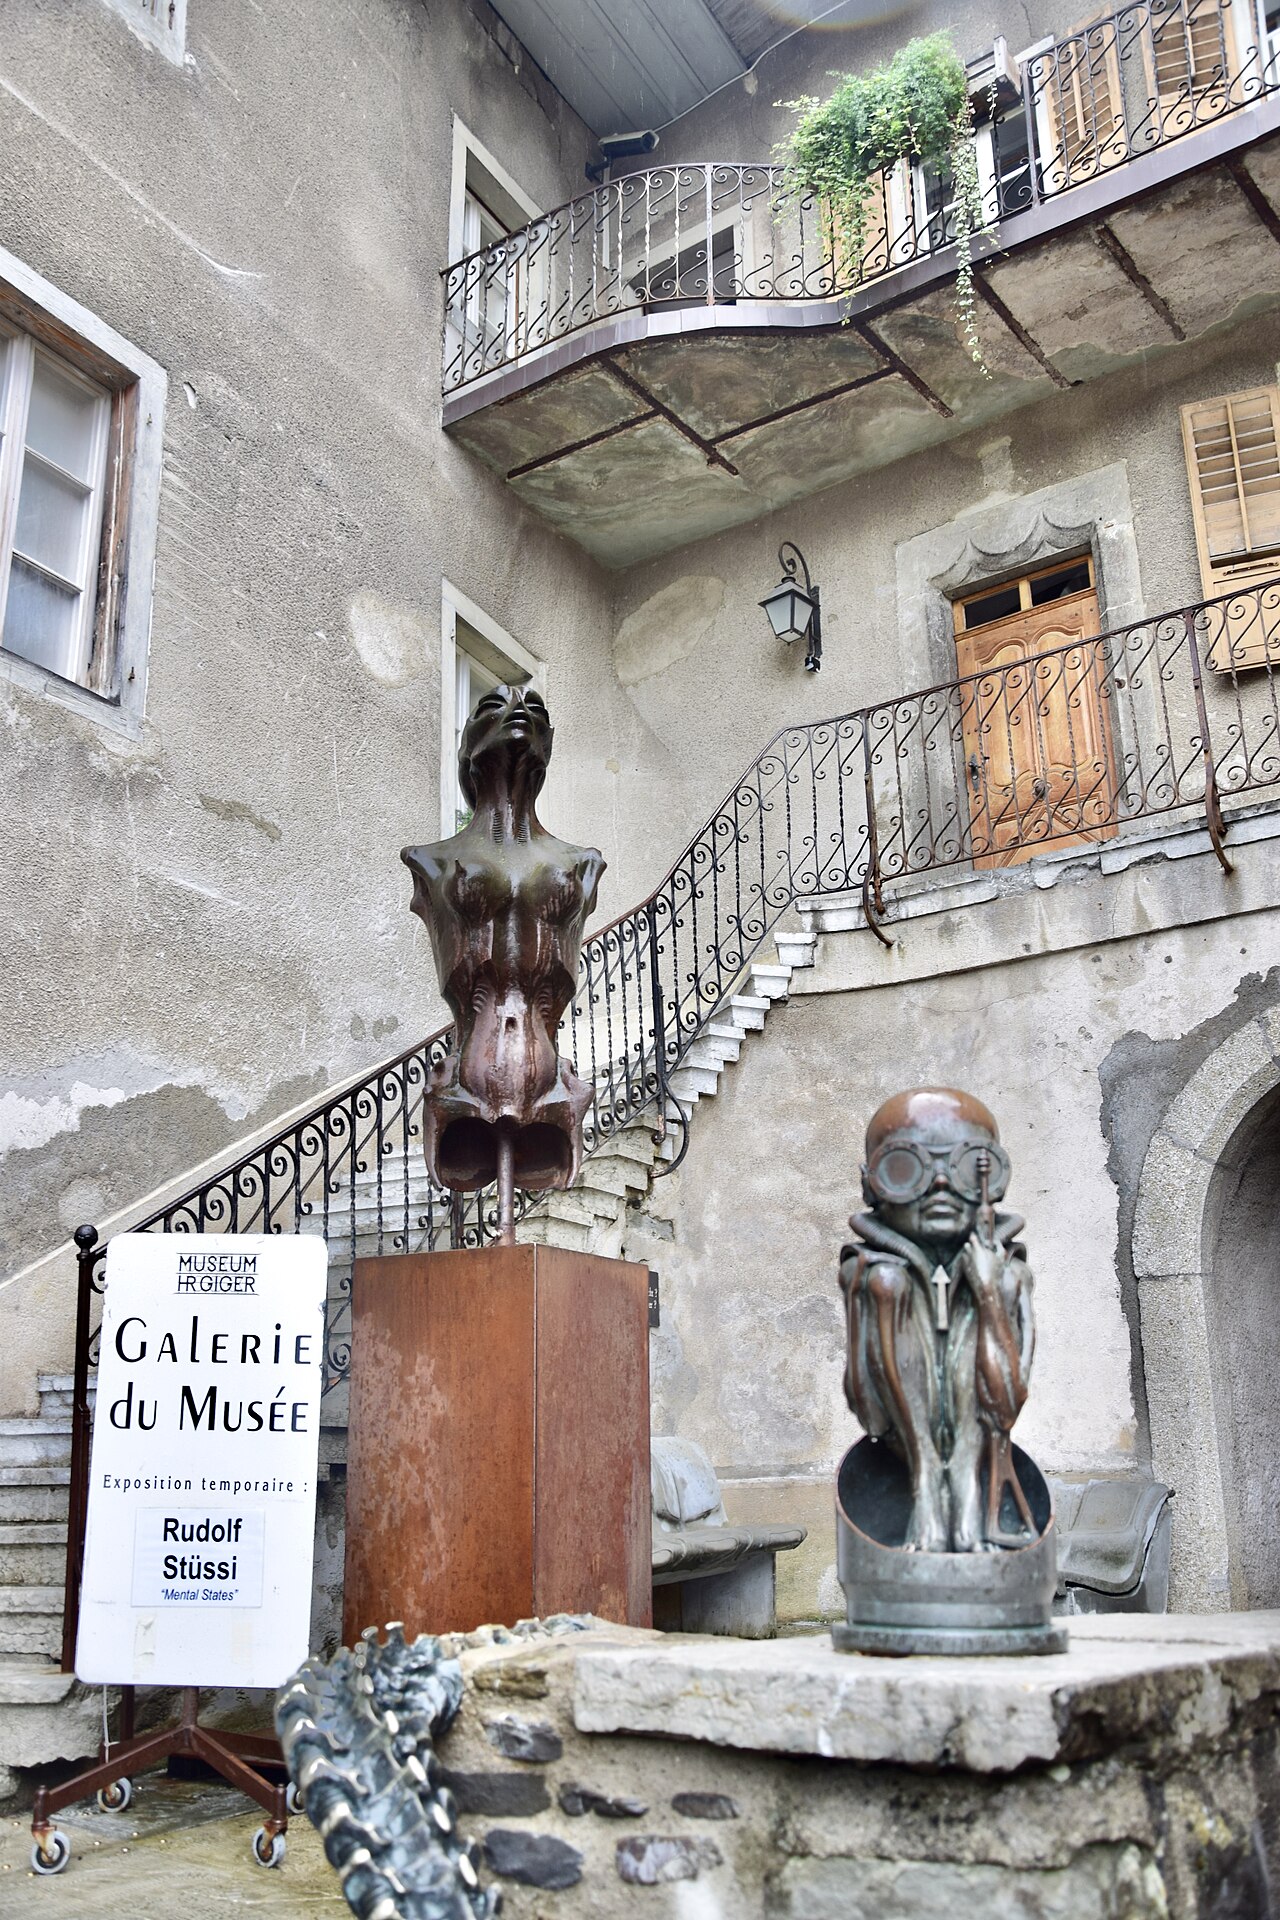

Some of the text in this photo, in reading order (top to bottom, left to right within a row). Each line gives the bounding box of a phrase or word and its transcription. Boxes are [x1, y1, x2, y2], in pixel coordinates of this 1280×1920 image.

[178, 1254, 258, 1273] MUSEUM
[103, 1474, 192, 1493] Exposition
[201, 1476, 293, 1496] temporaire
[163, 1517, 243, 1543] Rudolf
[163, 1554, 238, 1581] Stüssi
